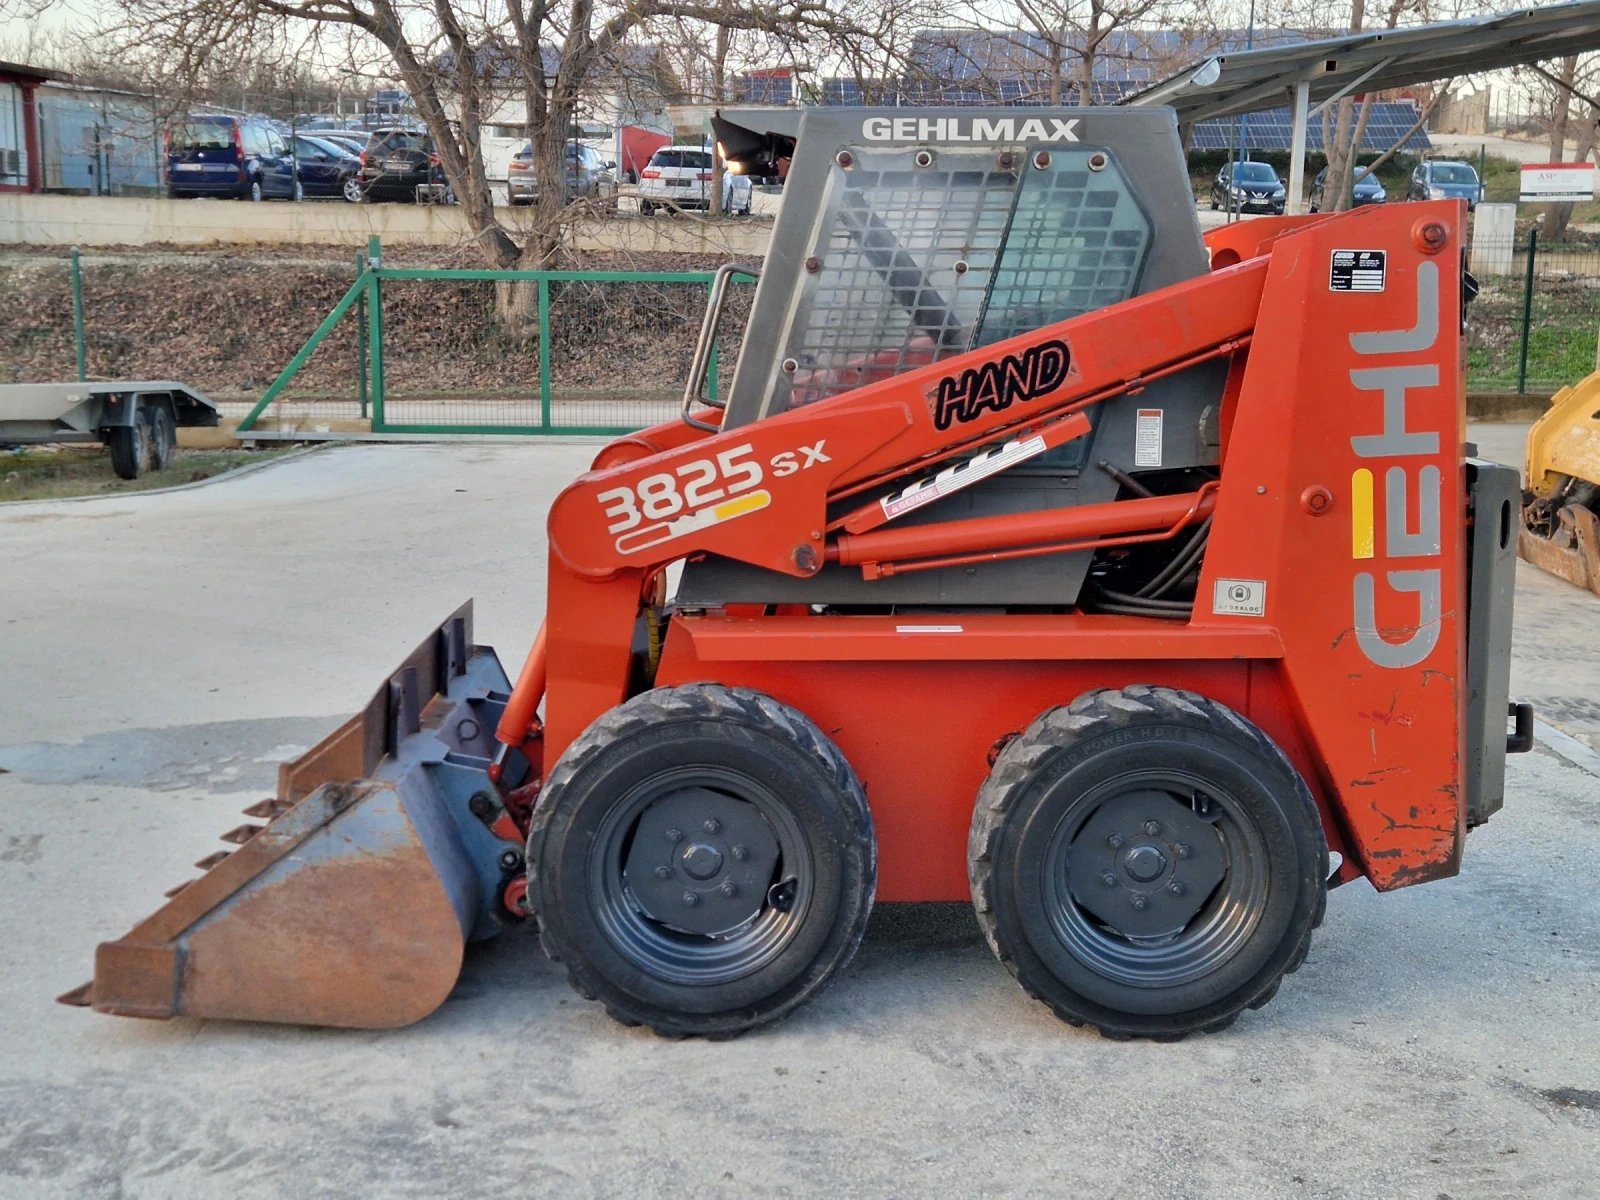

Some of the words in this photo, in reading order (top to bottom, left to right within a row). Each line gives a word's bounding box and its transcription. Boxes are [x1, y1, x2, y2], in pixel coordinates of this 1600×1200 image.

[862, 117, 1080, 142] GEHLMAX
[934, 340, 1071, 431] HAND
[597, 443, 763, 535] 3825
[1349, 261, 1441, 668] GEHL
[1083, 731, 1133, 755] POWER
